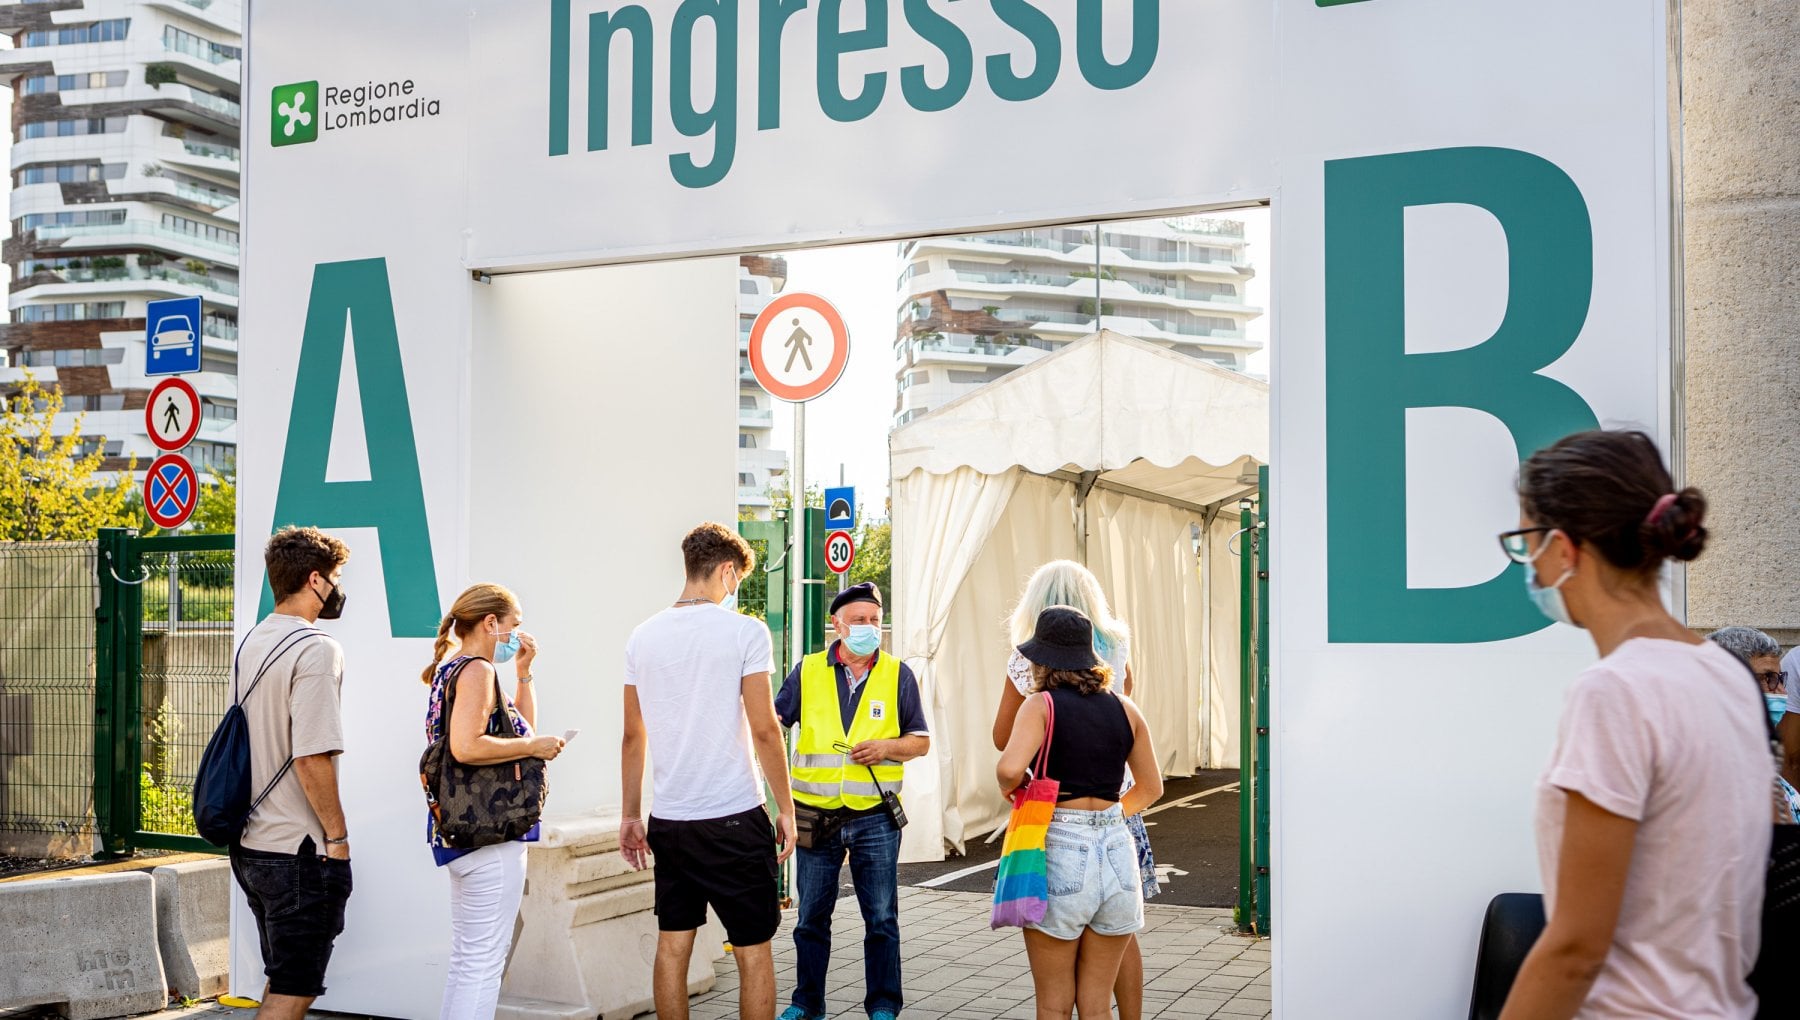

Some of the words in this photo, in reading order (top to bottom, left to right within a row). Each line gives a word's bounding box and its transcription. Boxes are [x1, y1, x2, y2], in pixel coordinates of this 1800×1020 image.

[325, 79, 415, 108] Regione
[325, 97, 440, 131] Lombardia
[549, 0, 1159, 188] Ingresso
[257, 257, 441, 638] A
[1325, 146, 1599, 644] B
[831, 542, 849, 562] 30
